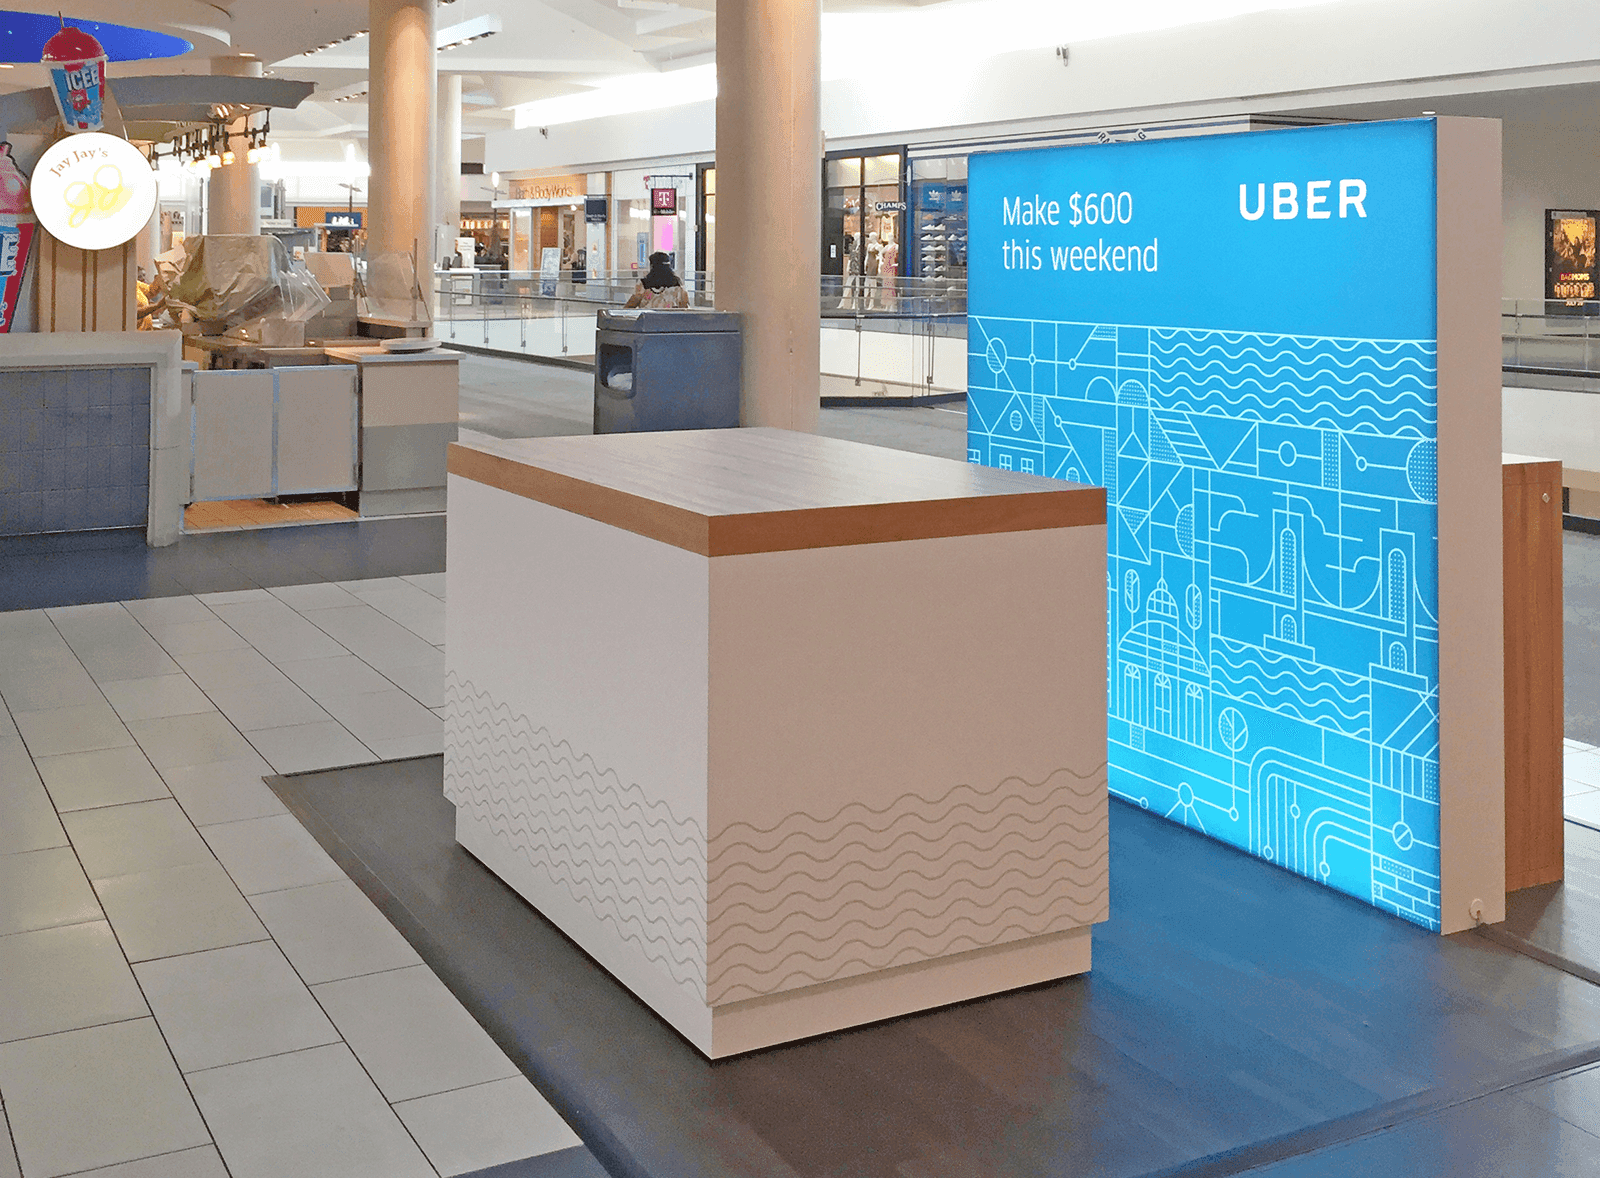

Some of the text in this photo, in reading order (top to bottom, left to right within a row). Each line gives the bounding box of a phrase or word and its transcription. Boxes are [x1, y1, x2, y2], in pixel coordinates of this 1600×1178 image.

[64, 64, 100, 92] ICEE
[49, 147, 108, 177] Jay Jay's
[876, 201, 907, 211] CHAMPS
[1003, 191, 1133, 228] Make $600
[1239, 178, 1368, 221] UBER
[1002, 238, 1158, 272] this weekend
